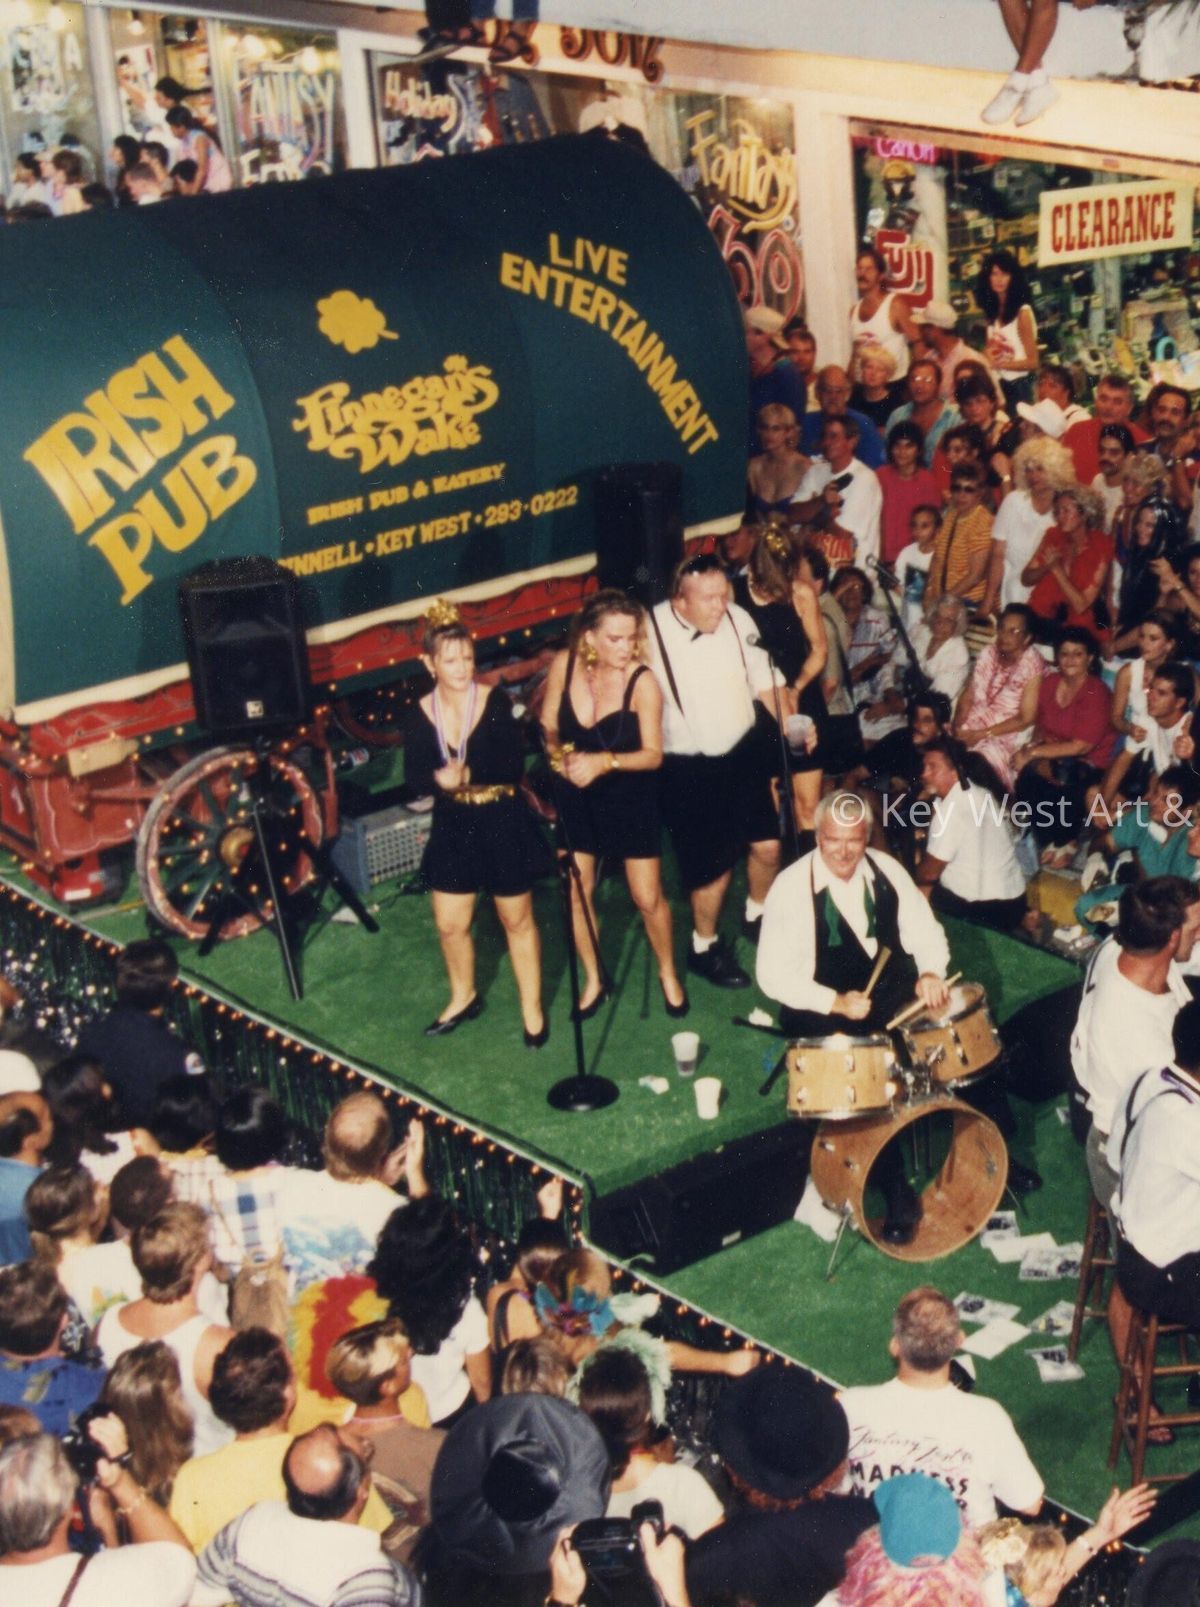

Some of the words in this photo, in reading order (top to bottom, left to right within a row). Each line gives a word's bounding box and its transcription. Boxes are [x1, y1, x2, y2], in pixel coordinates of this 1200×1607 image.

[876, 136, 936, 163] Canon
[1051, 190, 1176, 254] CLEARANCE
[549, 232, 629, 287] LIVE
[501, 251, 720, 456] ENTERTAINMENT
[22, 333, 236, 536] IRISH
[369, 485, 409, 510] PUB
[433, 462, 506, 494] EATERY
[88, 434, 258, 607] PUB
[376, 525, 416, 557] KEY
[420, 511, 472, 544] WEST
